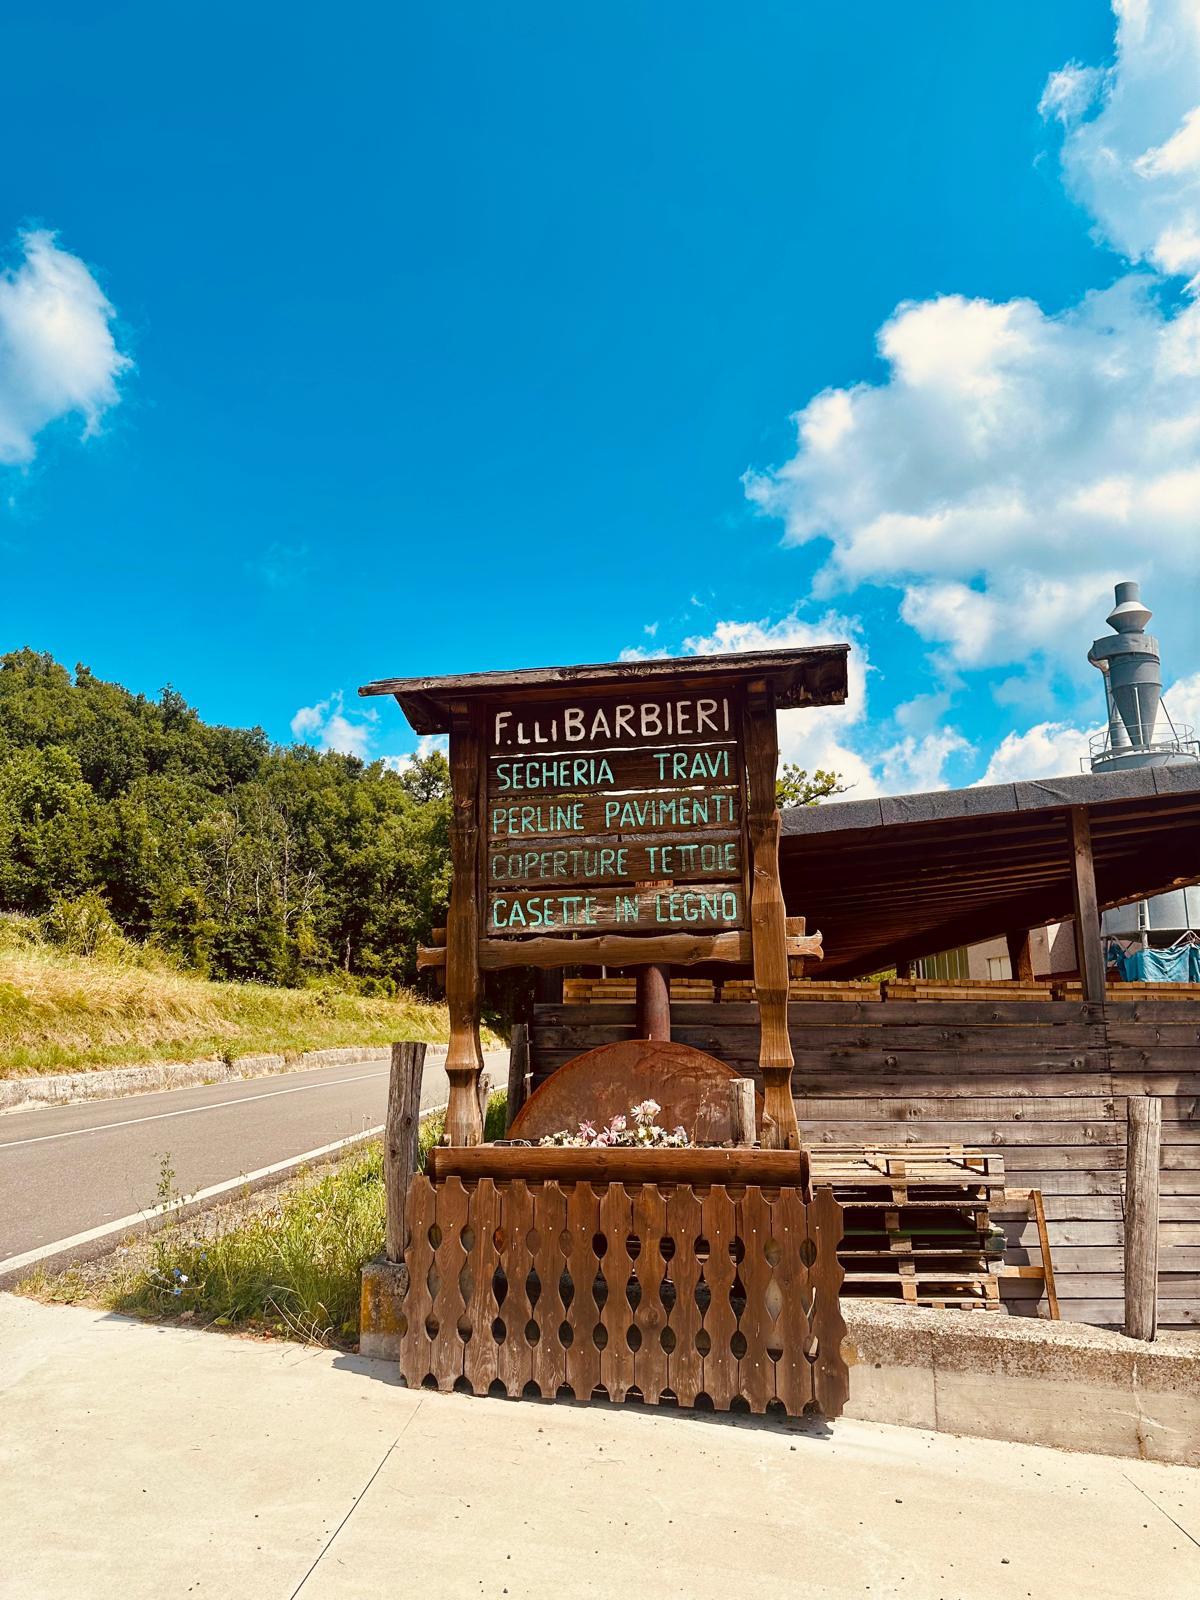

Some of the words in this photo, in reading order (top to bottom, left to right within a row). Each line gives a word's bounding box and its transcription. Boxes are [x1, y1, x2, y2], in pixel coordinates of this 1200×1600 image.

[564, 699, 729, 741] BARBIERI
[497, 758, 614, 791] SEGHERIA
[653, 751, 729, 780] TRAVI
[493, 803, 584, 834] PERLINE
[605, 795, 734, 828] PAVIMENTI
[492, 848, 628, 880] COPERTURE
[645, 844, 736, 874] TETTOIE
[493, 897, 596, 927] CASETTE
[616, 895, 639, 922] IN
[656, 892, 737, 922] LEGNO
